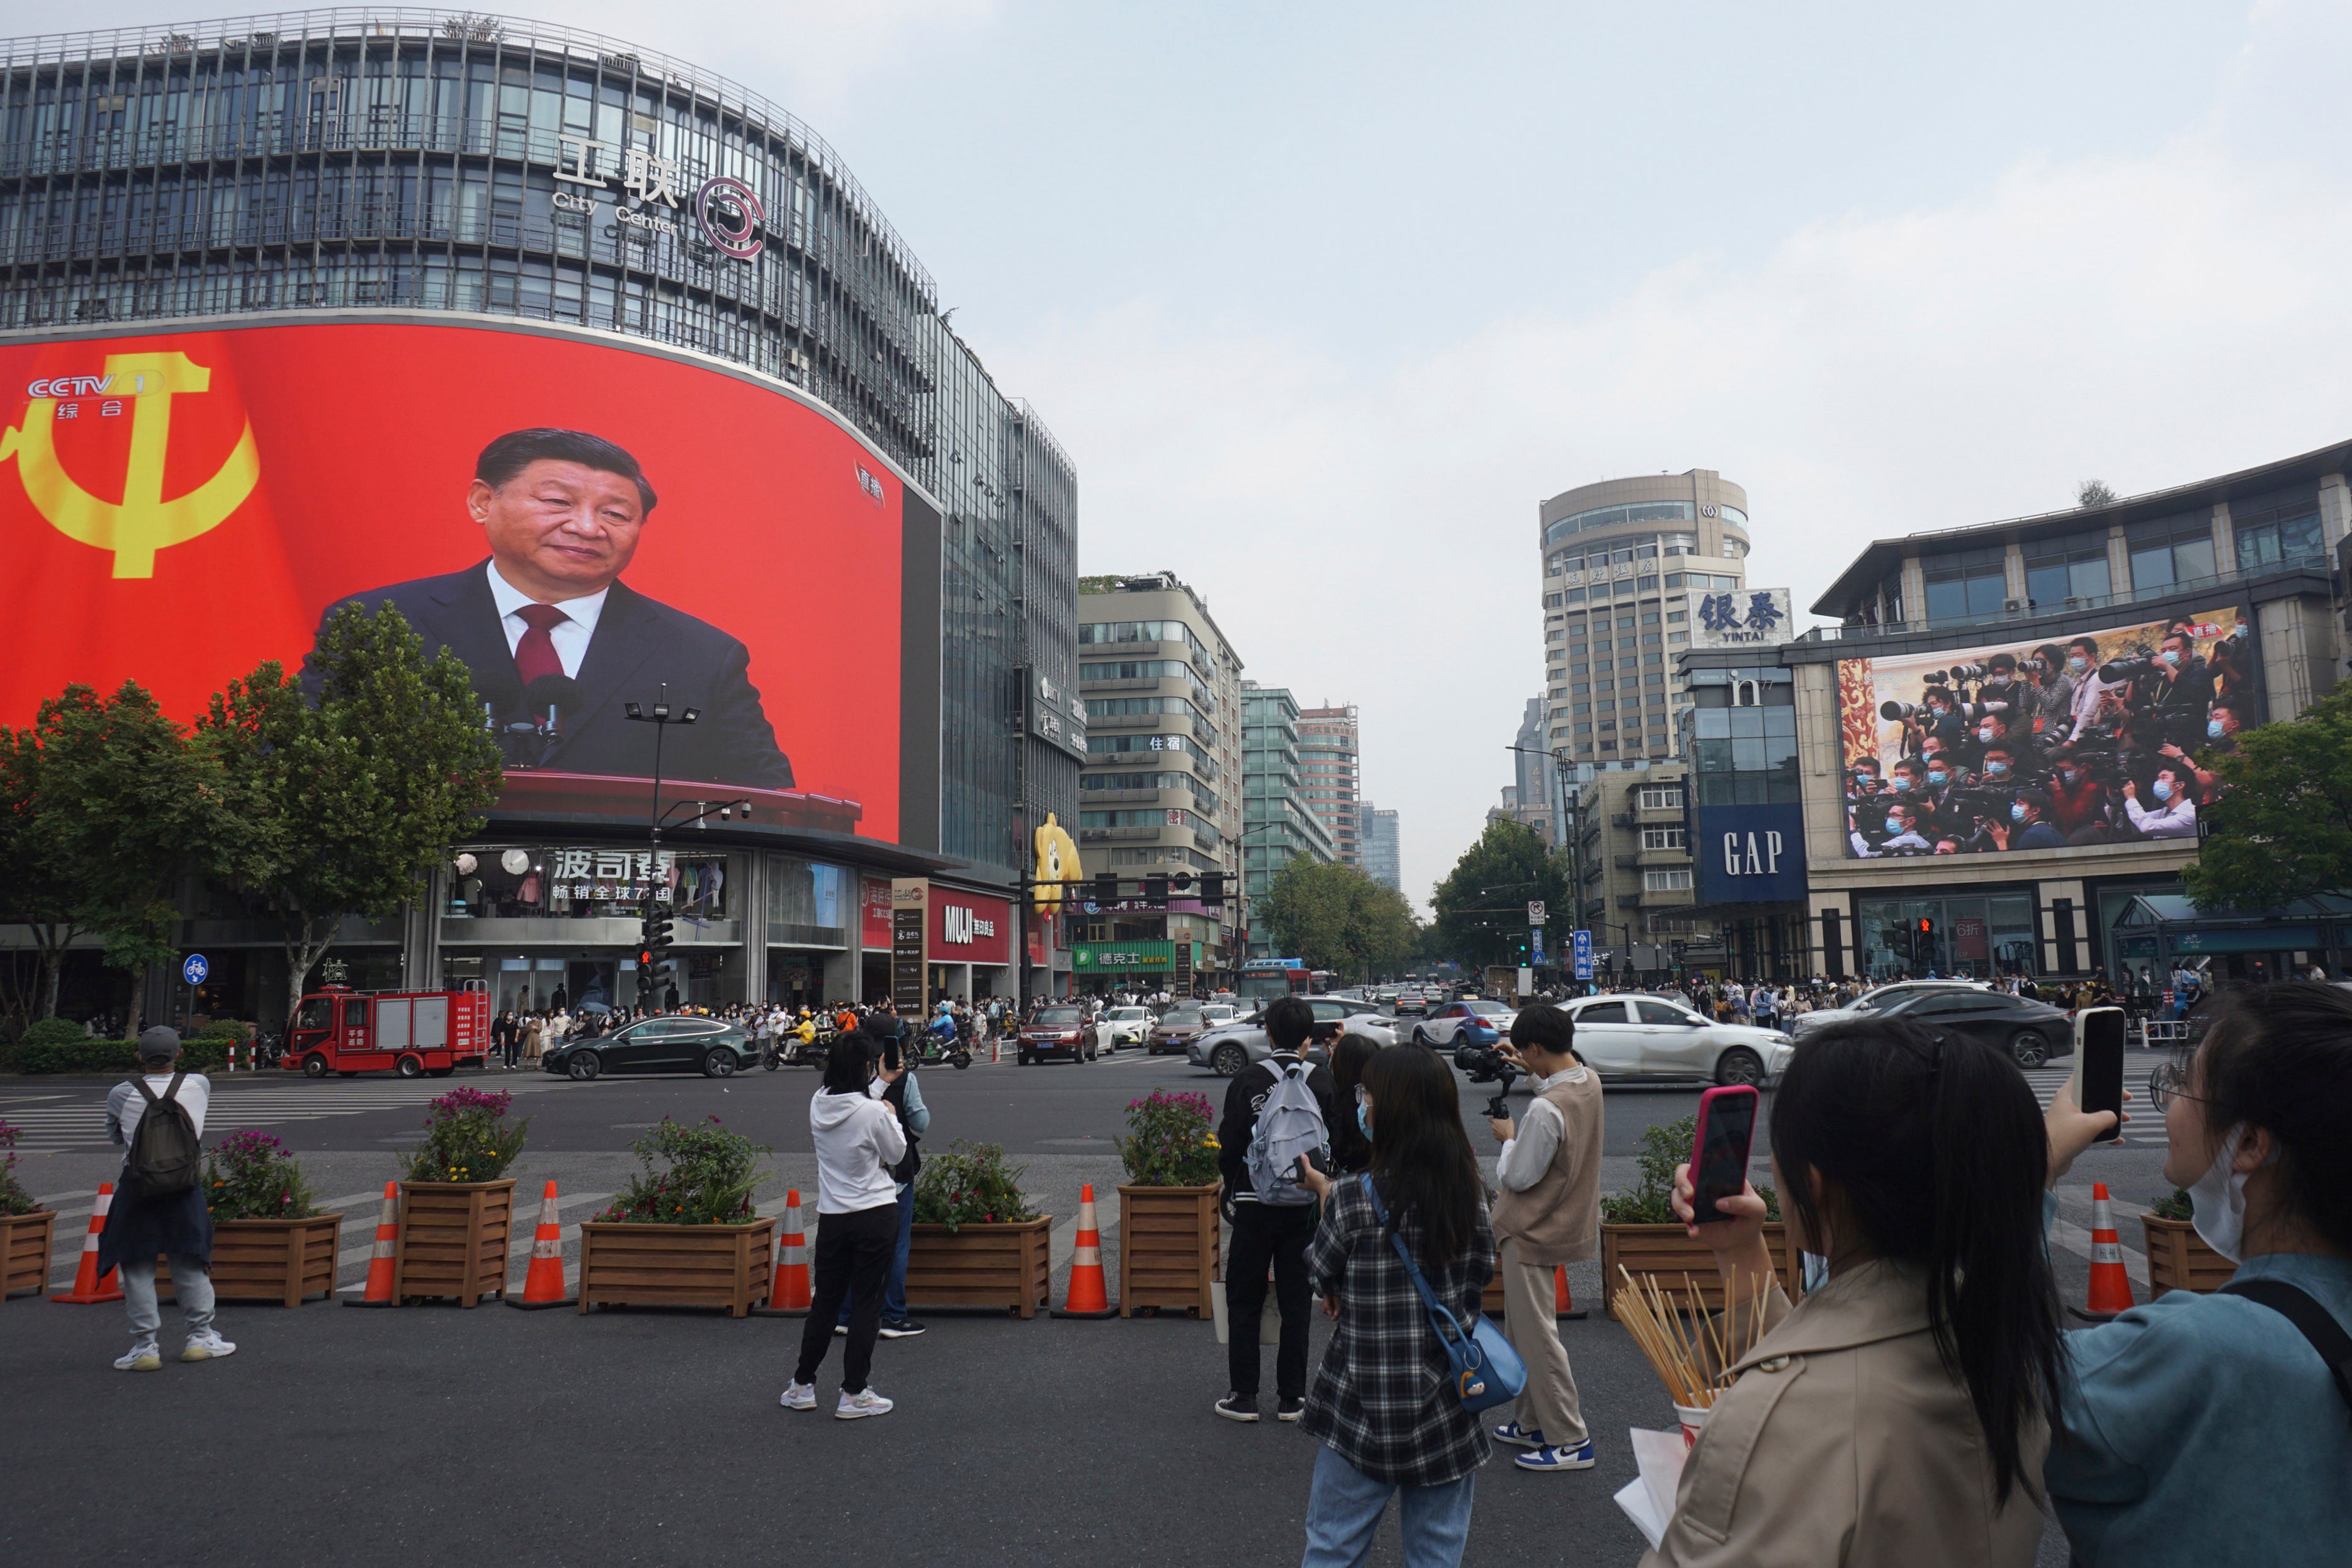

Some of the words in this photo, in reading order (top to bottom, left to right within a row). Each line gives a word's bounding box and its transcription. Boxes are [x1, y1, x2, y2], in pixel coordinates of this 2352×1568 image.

[553, 134, 678, 209] 工联
[552, 192, 599, 215] City
[616, 206, 678, 236] Center
[28, 374, 116, 398] CCTV
[134, 375, 144, 393] 1
[57, 400, 122, 419] 综合
[860, 468, 881, 500] 直播
[1699, 592, 1784, 630] 银泰
[1723, 631, 1765, 642] YINTAI
[2192, 624, 2217, 637] 直播
[1150, 736, 1180, 751] 住宿
[553, 850, 670, 881] 波司登
[1724, 831, 1782, 876] GAP
[945, 905, 973, 944] MUJI
[974, 918, 994, 937] 無印良品
[1957, 923, 1979, 936] 6折
[1099, 952, 1139, 964] 德克士
[1577, 946, 1587, 976] 平海路
[348, 1029, 364, 1037] 平安
